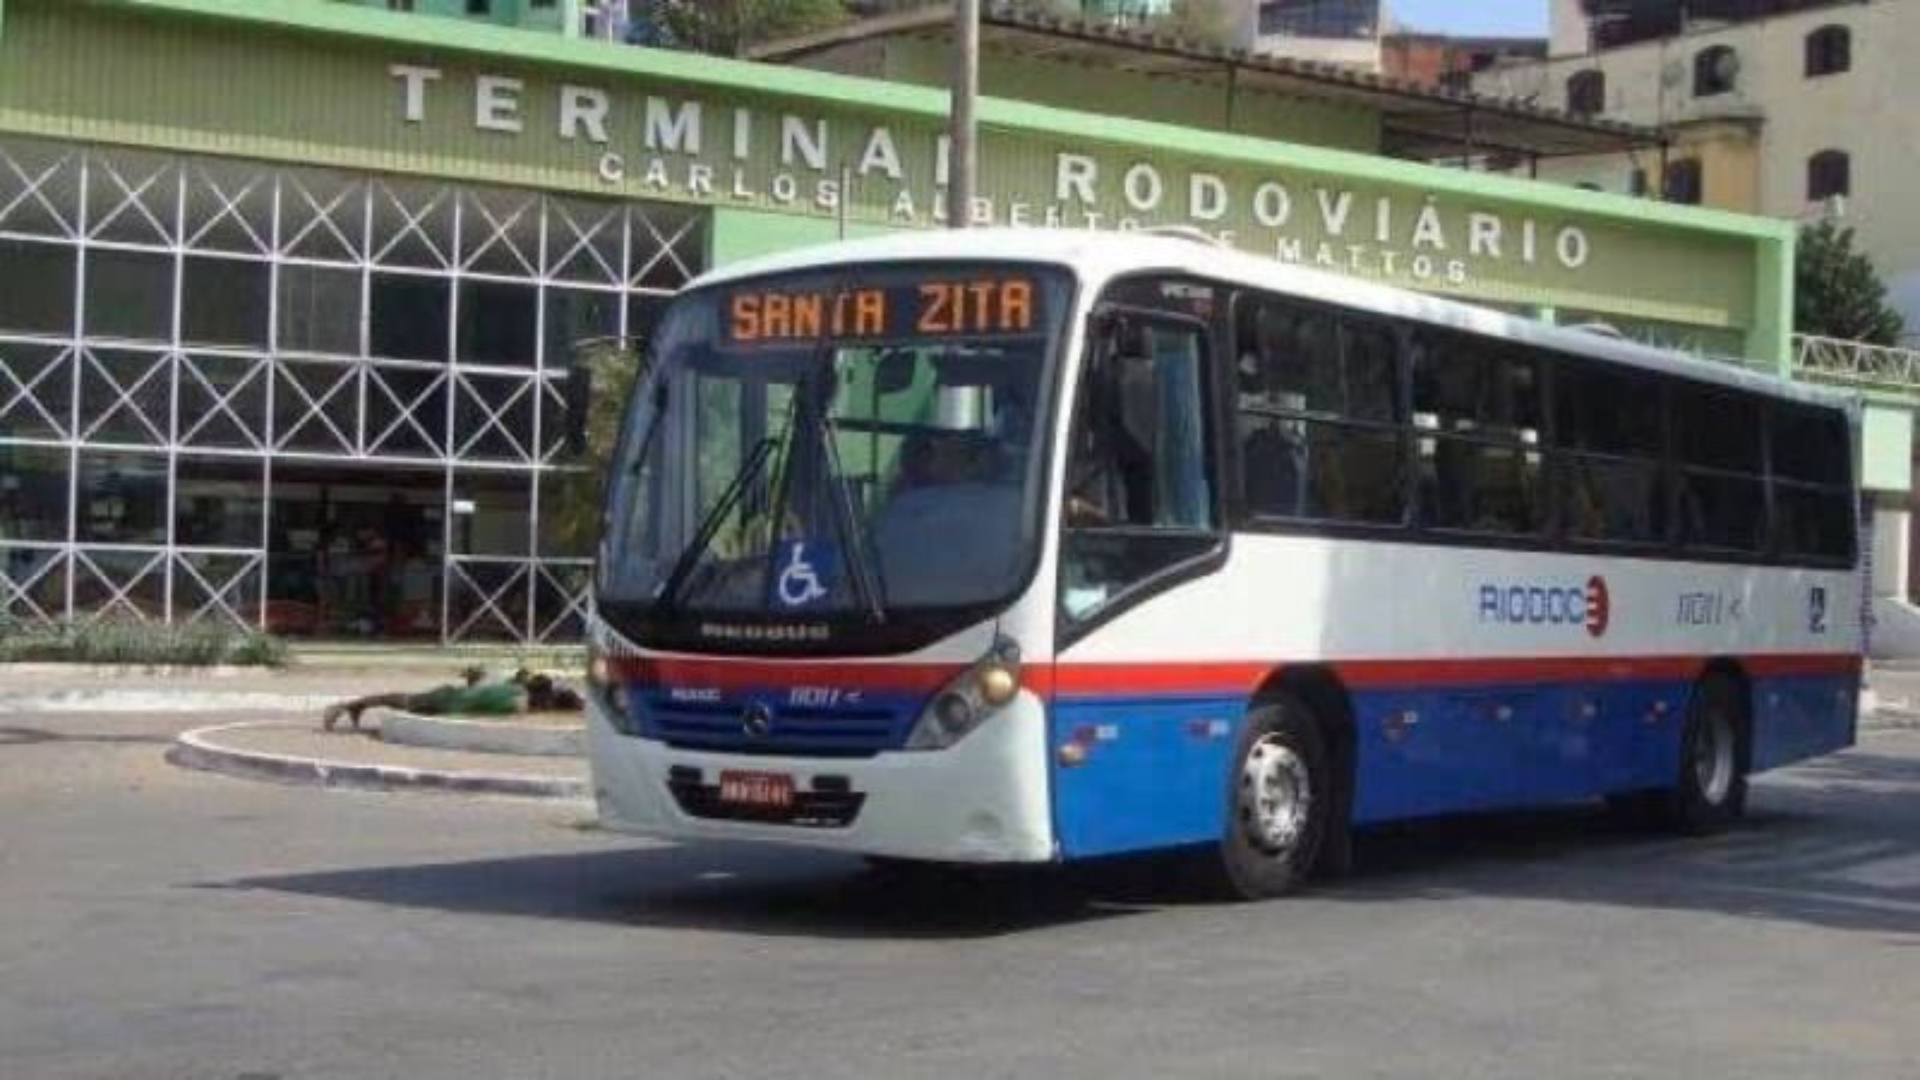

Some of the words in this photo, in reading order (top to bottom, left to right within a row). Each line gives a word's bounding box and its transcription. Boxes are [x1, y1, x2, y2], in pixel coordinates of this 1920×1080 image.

[600, 152, 839, 207] CARLOS
[1276, 238, 1467, 283] MATTOS
[1056, 152, 1588, 268] RODOVIÁRIO
[732, 290, 884, 340] SANTA
[917, 279, 1033, 334] ZITA
